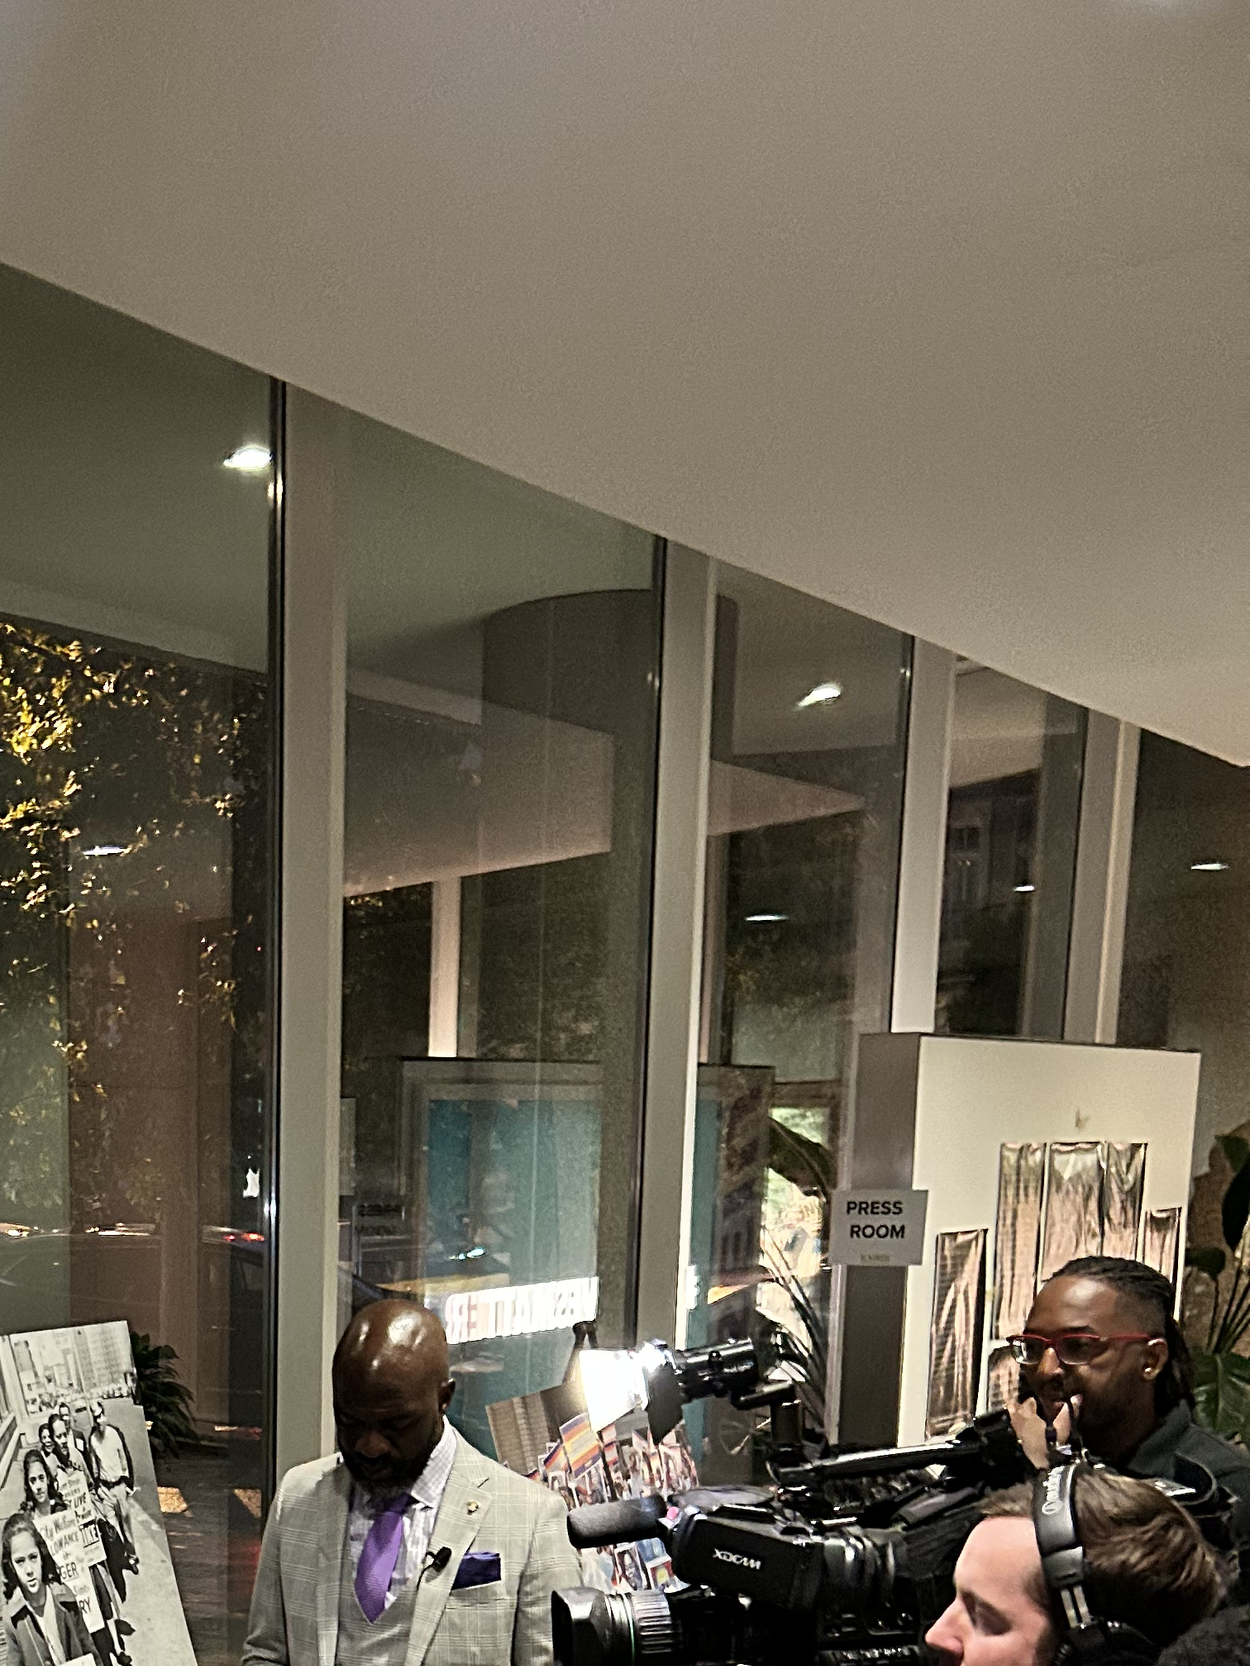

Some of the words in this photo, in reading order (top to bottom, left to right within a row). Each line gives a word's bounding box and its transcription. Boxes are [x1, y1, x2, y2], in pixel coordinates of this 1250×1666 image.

[846, 1201, 903, 1216] PRESS
[850, 1224, 905, 1239] ROOM
[712, 1548, 761, 1570] XDCAM
